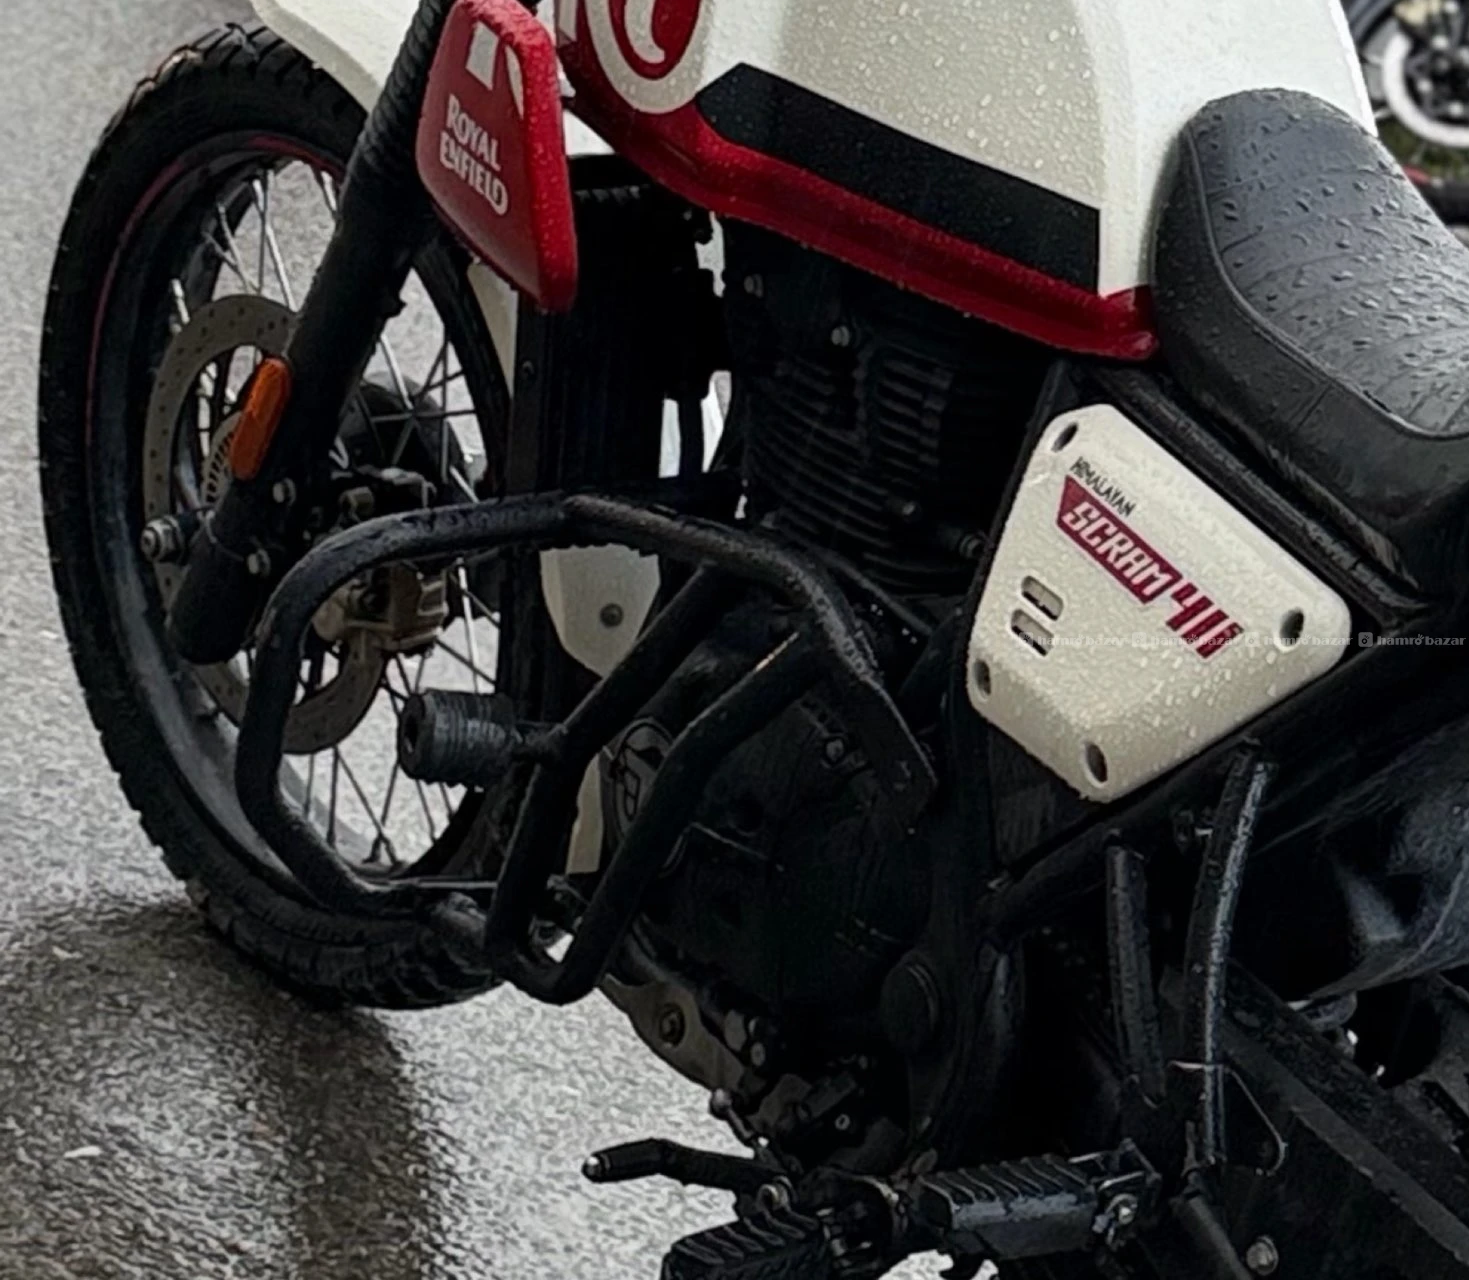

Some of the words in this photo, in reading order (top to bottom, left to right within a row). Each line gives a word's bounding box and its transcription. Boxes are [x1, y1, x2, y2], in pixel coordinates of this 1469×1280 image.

[446, 93, 501, 171] ROYAL
[440, 132, 508, 216] ENFIELD
[1069, 456, 1137, 517] HIMALAYAN
[1061, 501, 1173, 597] SCRAM
[1165, 582, 1245, 659] 411
